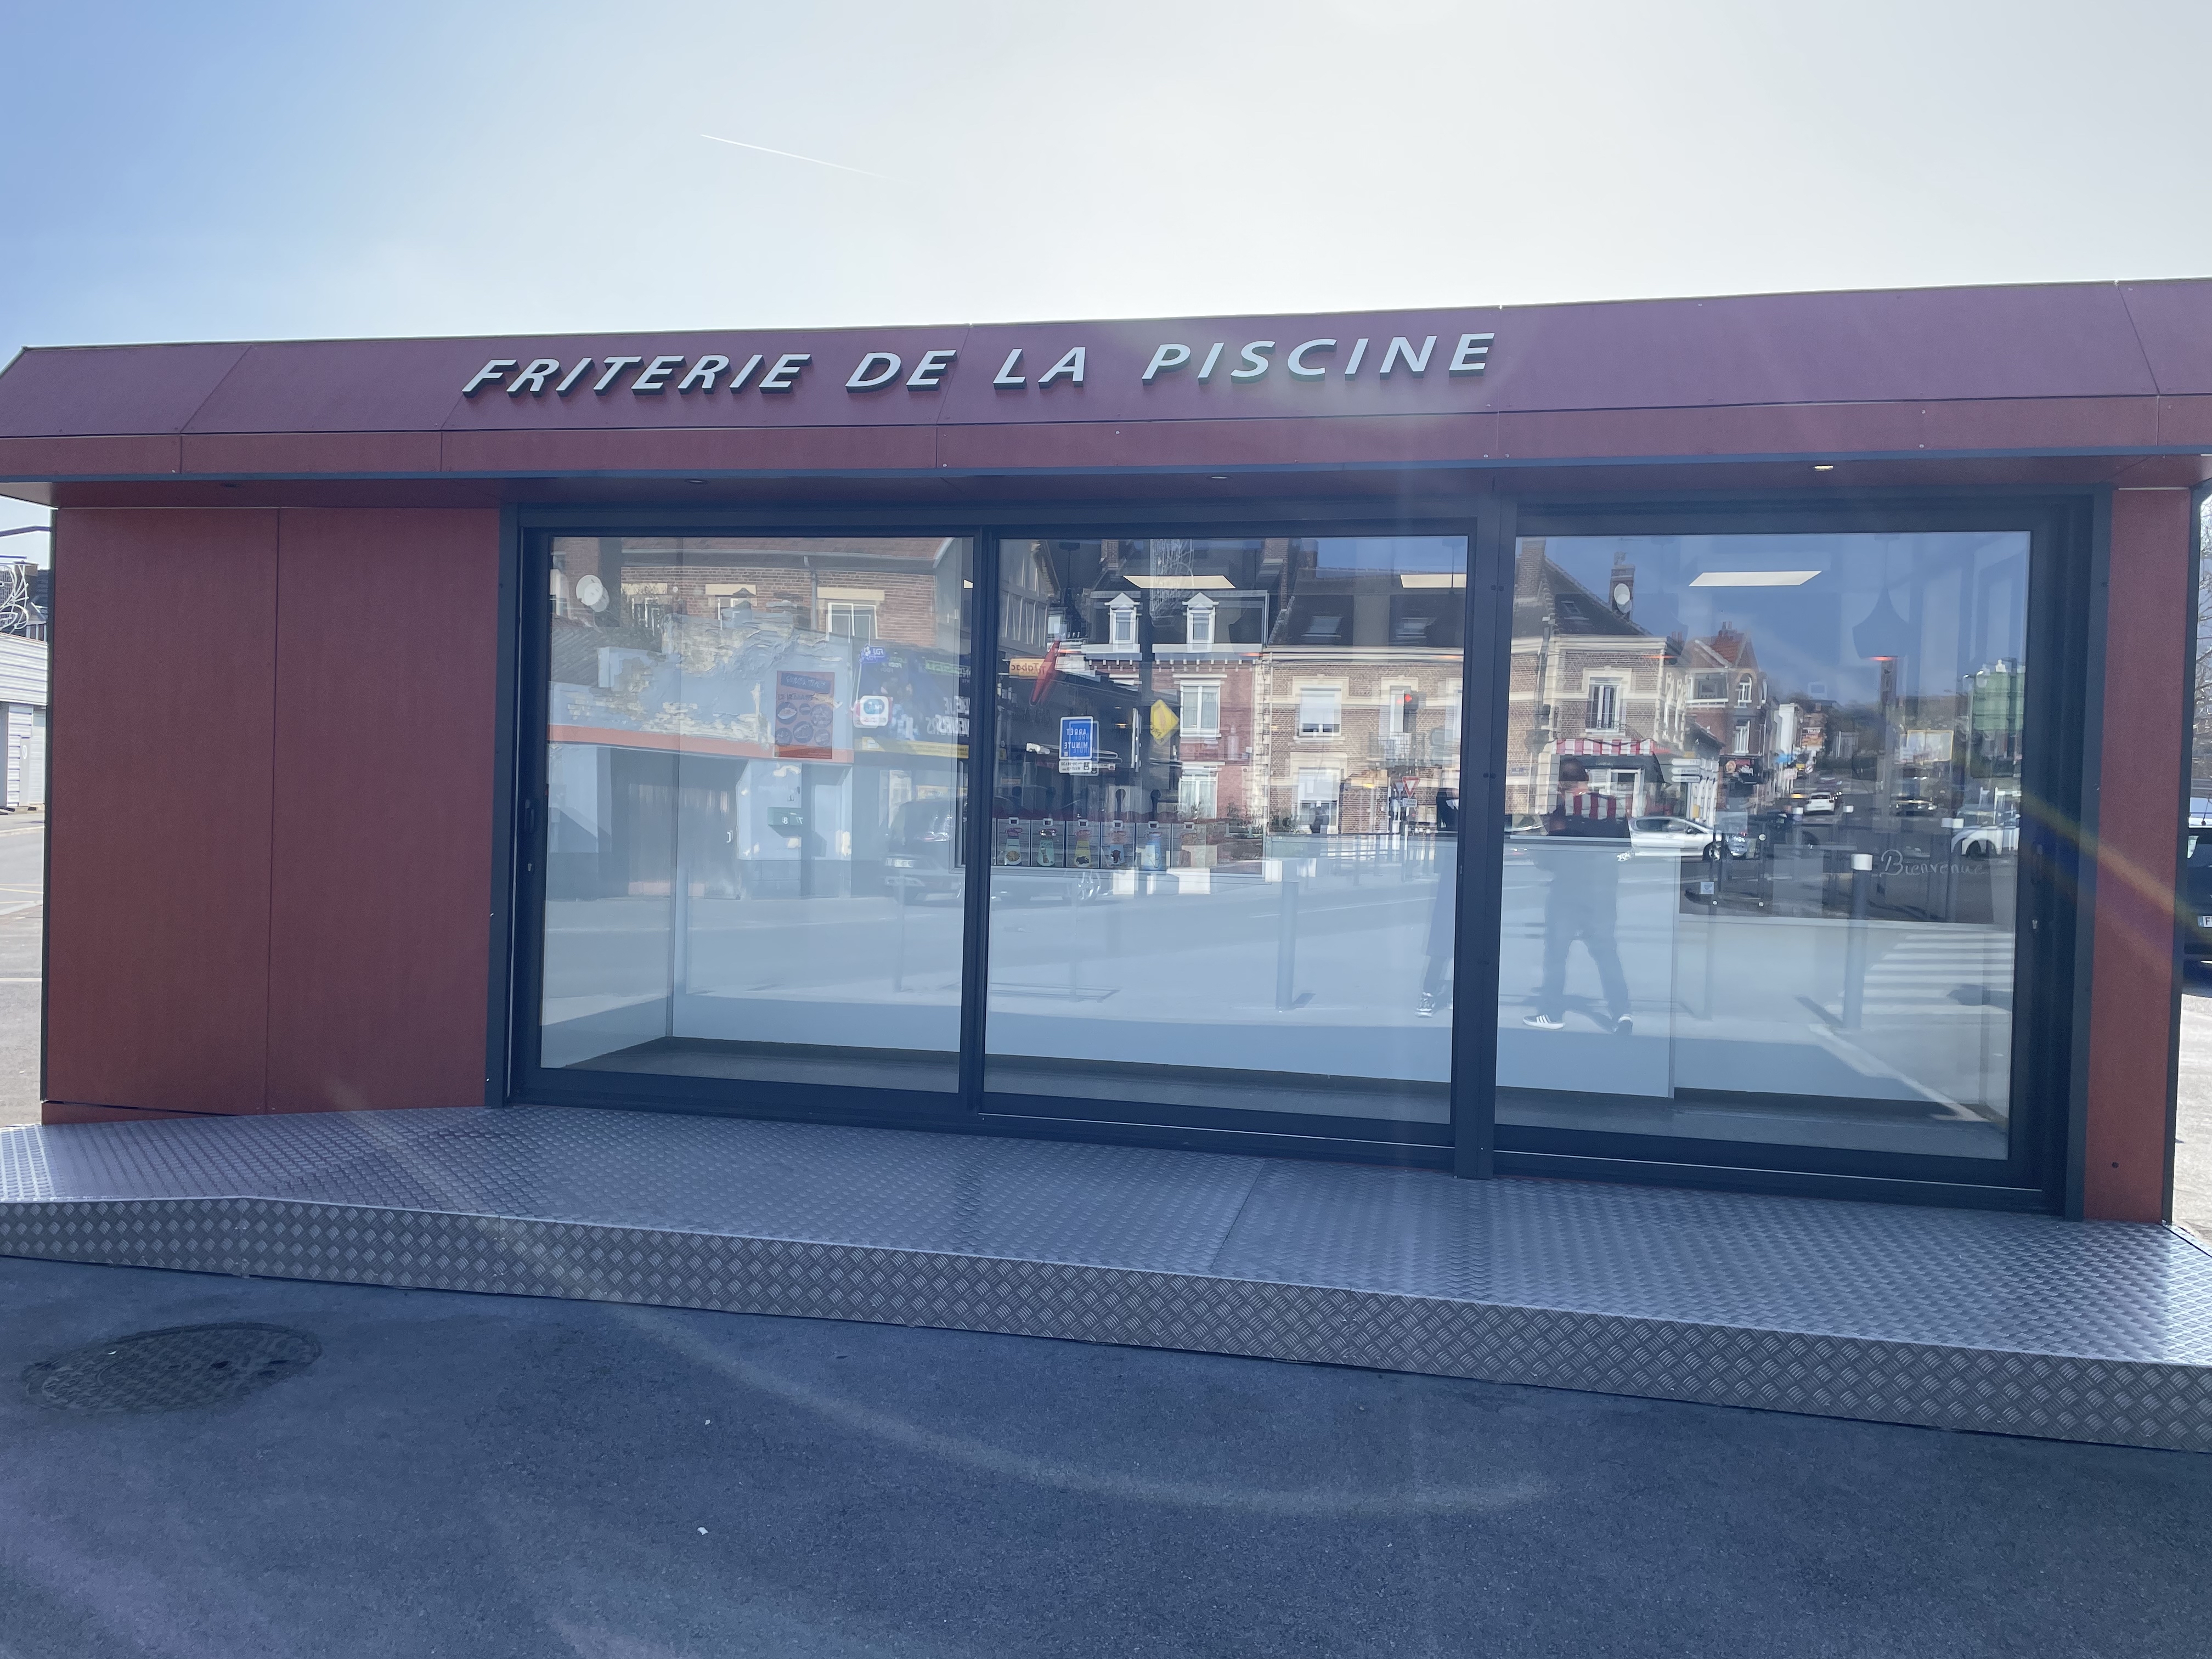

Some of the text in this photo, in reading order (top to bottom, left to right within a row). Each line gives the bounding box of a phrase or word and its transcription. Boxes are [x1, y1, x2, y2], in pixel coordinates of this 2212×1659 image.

[462, 332, 1495, 395] FRITERIE DE LA PISCINE
[1880, 849, 1989, 877] Bienvenue
